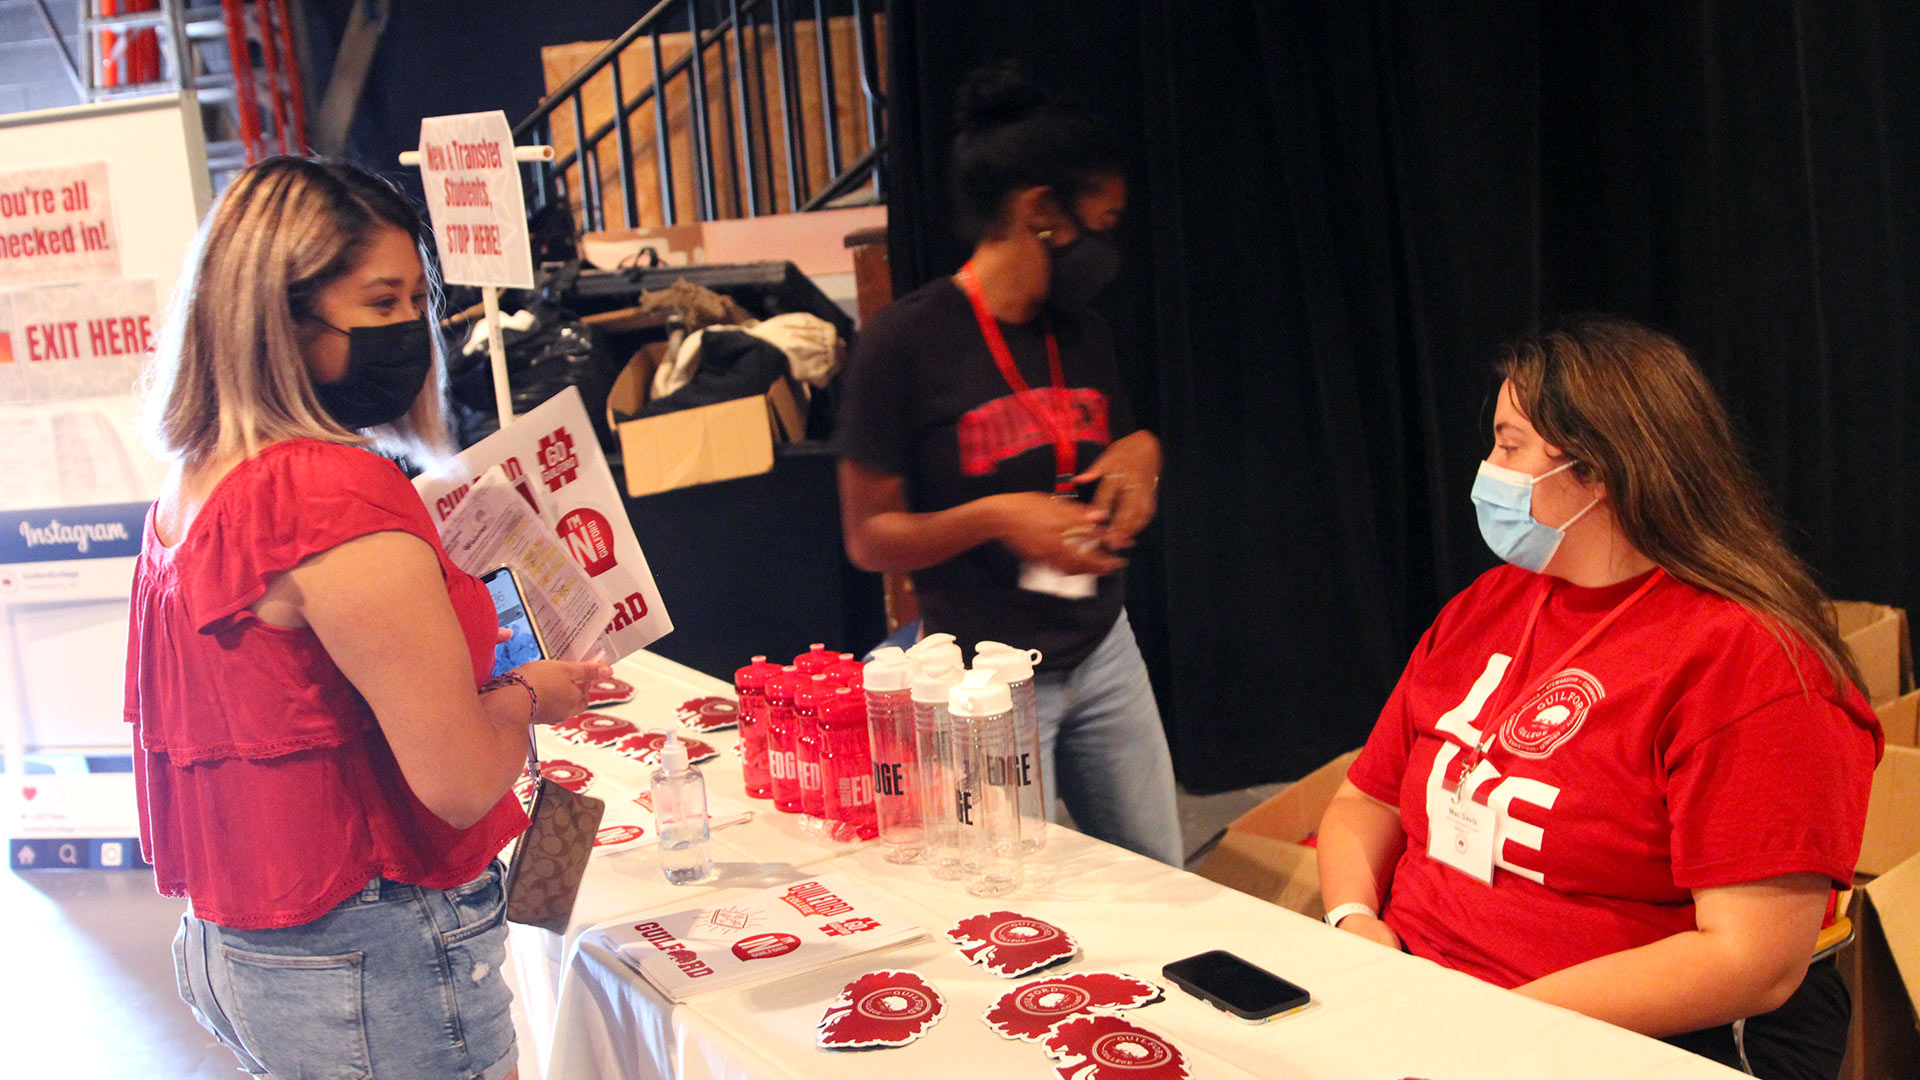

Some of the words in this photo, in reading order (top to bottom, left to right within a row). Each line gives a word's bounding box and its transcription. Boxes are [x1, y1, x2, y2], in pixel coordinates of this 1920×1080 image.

[426, 142, 446, 171] New
[452, 138, 502, 170] Transfer
[0, 186, 55, 218] ou're
[62, 180, 89, 212] all
[444, 176, 493, 211] Students,
[0, 224, 75, 259] hecked
[80, 219, 109, 252] in!
[447, 224, 470, 254] STOP
[473, 224, 502, 256] HERE!
[26, 321, 79, 361] EXIT
[88, 315, 155, 357] HERE
[19, 519, 128, 553] Instagram
[587, 519, 609, 559] GUILFORD
[768, 749, 797, 779] EDG
[873, 761, 904, 796] DGE
[787, 881, 855, 917] GUILFORD
[634, 922, 714, 978] GUILFRD
